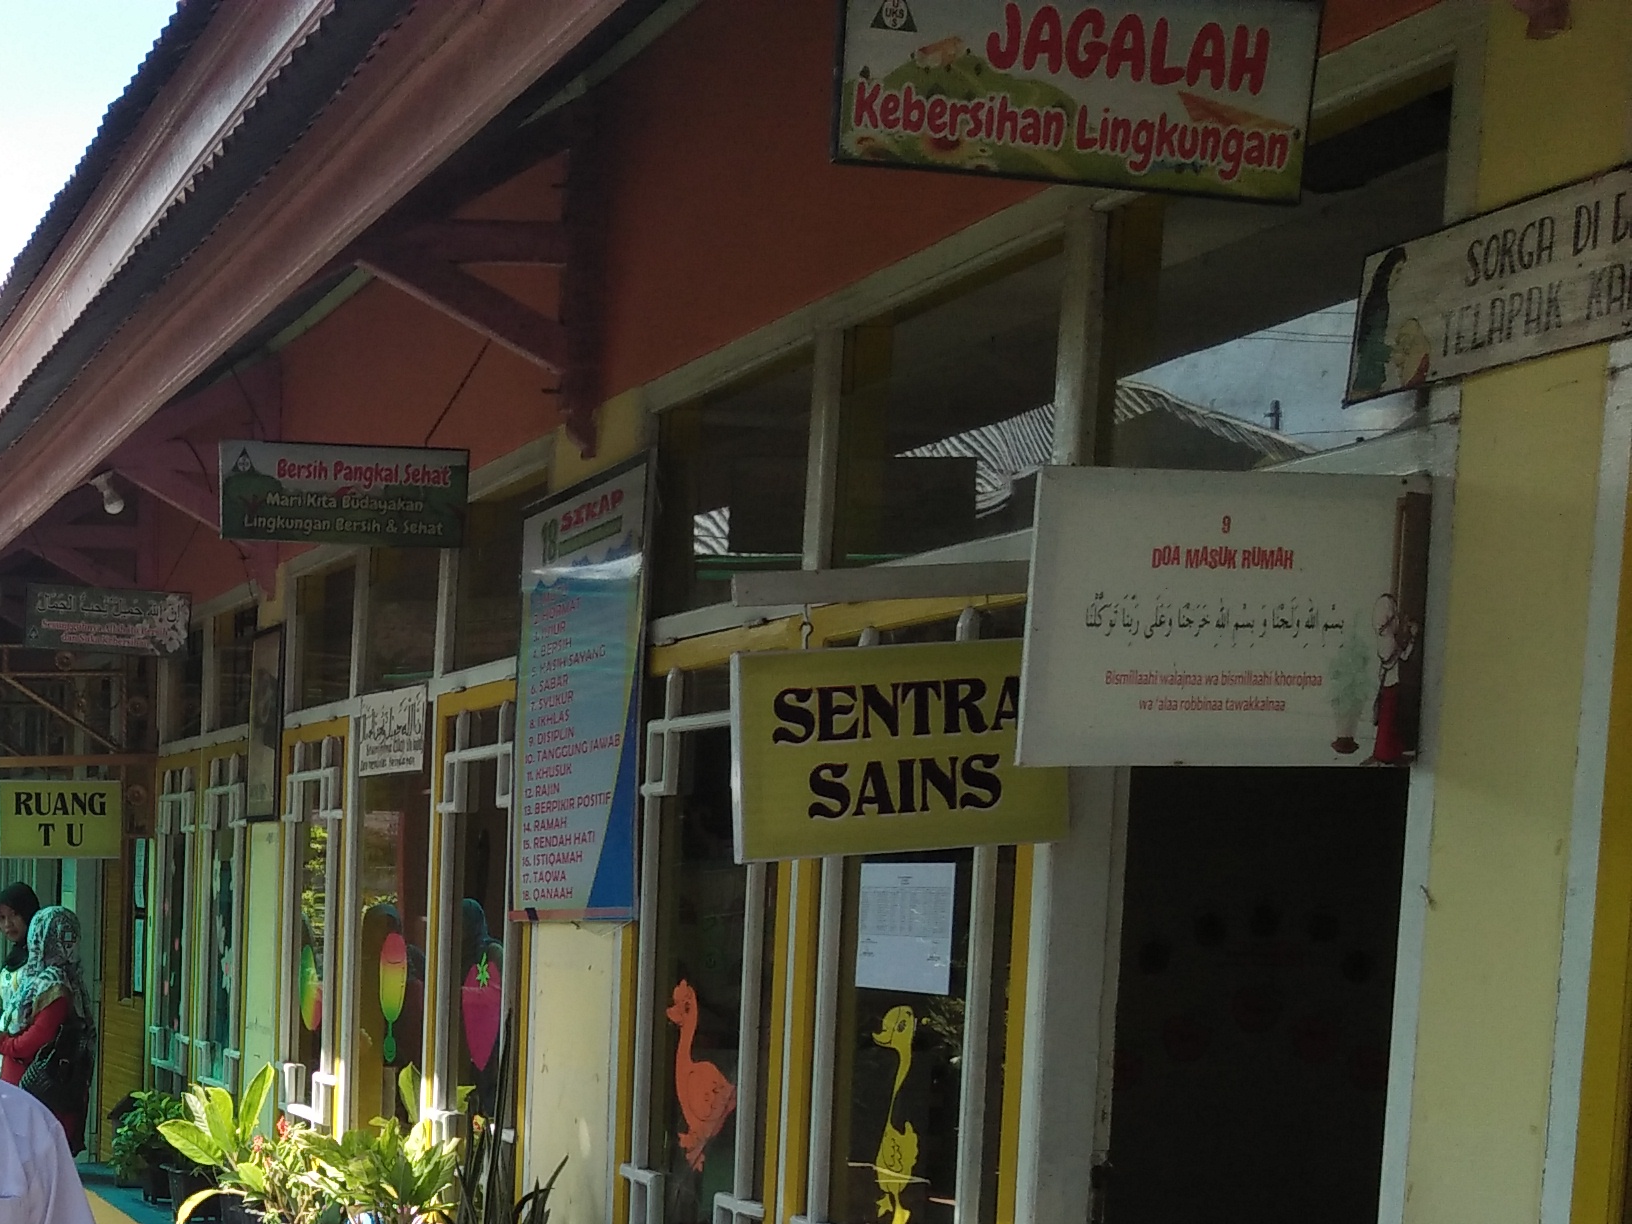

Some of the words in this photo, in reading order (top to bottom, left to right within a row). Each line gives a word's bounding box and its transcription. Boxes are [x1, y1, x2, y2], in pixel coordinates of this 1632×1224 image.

[985, 2, 1269, 96] JAGALAH
[853, 81, 1067, 148] Kebersihan
[1075, 104, 1290, 181] Lingkungan
[1465, 215, 1556, 288] SORGA
[1571, 200, 1601, 257] DI
[1442, 280, 1563, 357] TELAPAK
[1585, 262, 1632, 321] KA
[276, 458, 328, 481] Bersih
[333, 461, 399, 489] Pangkal
[402, 463, 449, 486] Sehat
[266, 492, 303, 507] Mari
[307, 493, 337, 508] Kita
[342, 494, 424, 515] Budayakan
[244, 513, 331, 535] Lingkungan
[335, 517, 381, 533] Bersih
[386, 519, 397, 533] &
[402, 519, 444, 536] Sehat
[541, 518, 558, 566] 18
[560, 489, 624, 533] SIKAP
[1152, 545, 1180, 569] DOA
[1185, 546, 1237, 569] MASUK
[1241, 546, 1294, 569] RUMAH
[568, 644, 606, 667] SAYANG
[539, 674, 569, 693] SABAR
[1105, 670, 1158, 686] Bismillaahi
[1205, 674, 1219, 686] wa
[1221, 670, 1272, 686] bismillaahi
[1274, 670, 1322, 689] khorojnaa
[539, 690, 574, 710] SYUKUR
[772, 675, 1021, 744] SENTRA
[1139, 699, 1152, 711] wa
[1180, 695, 1223, 711] robbinaa
[1225, 695, 1286, 711] tawakkalnaa
[537, 709, 570, 727] IKHLAS
[537, 726, 575, 745] DISIPLIN
[537, 741, 589, 762] TANGGUNG
[535, 763, 572, 779] KHUSUK
[808, 754, 1002, 820] SAINS
[14, 791, 107, 816] RUANG
[534, 798, 575, 814] BERPIKIR
[577, 791, 611, 808] POSITIF
[533, 816, 567, 832] RAMAH
[533, 833, 572, 849] RENDAH
[573, 831, 596, 844] HATI
[533, 851, 583, 866] ISTIQAMAH
[533, 870, 566, 883] TAQWA
[533, 887, 573, 901] QANAAH
